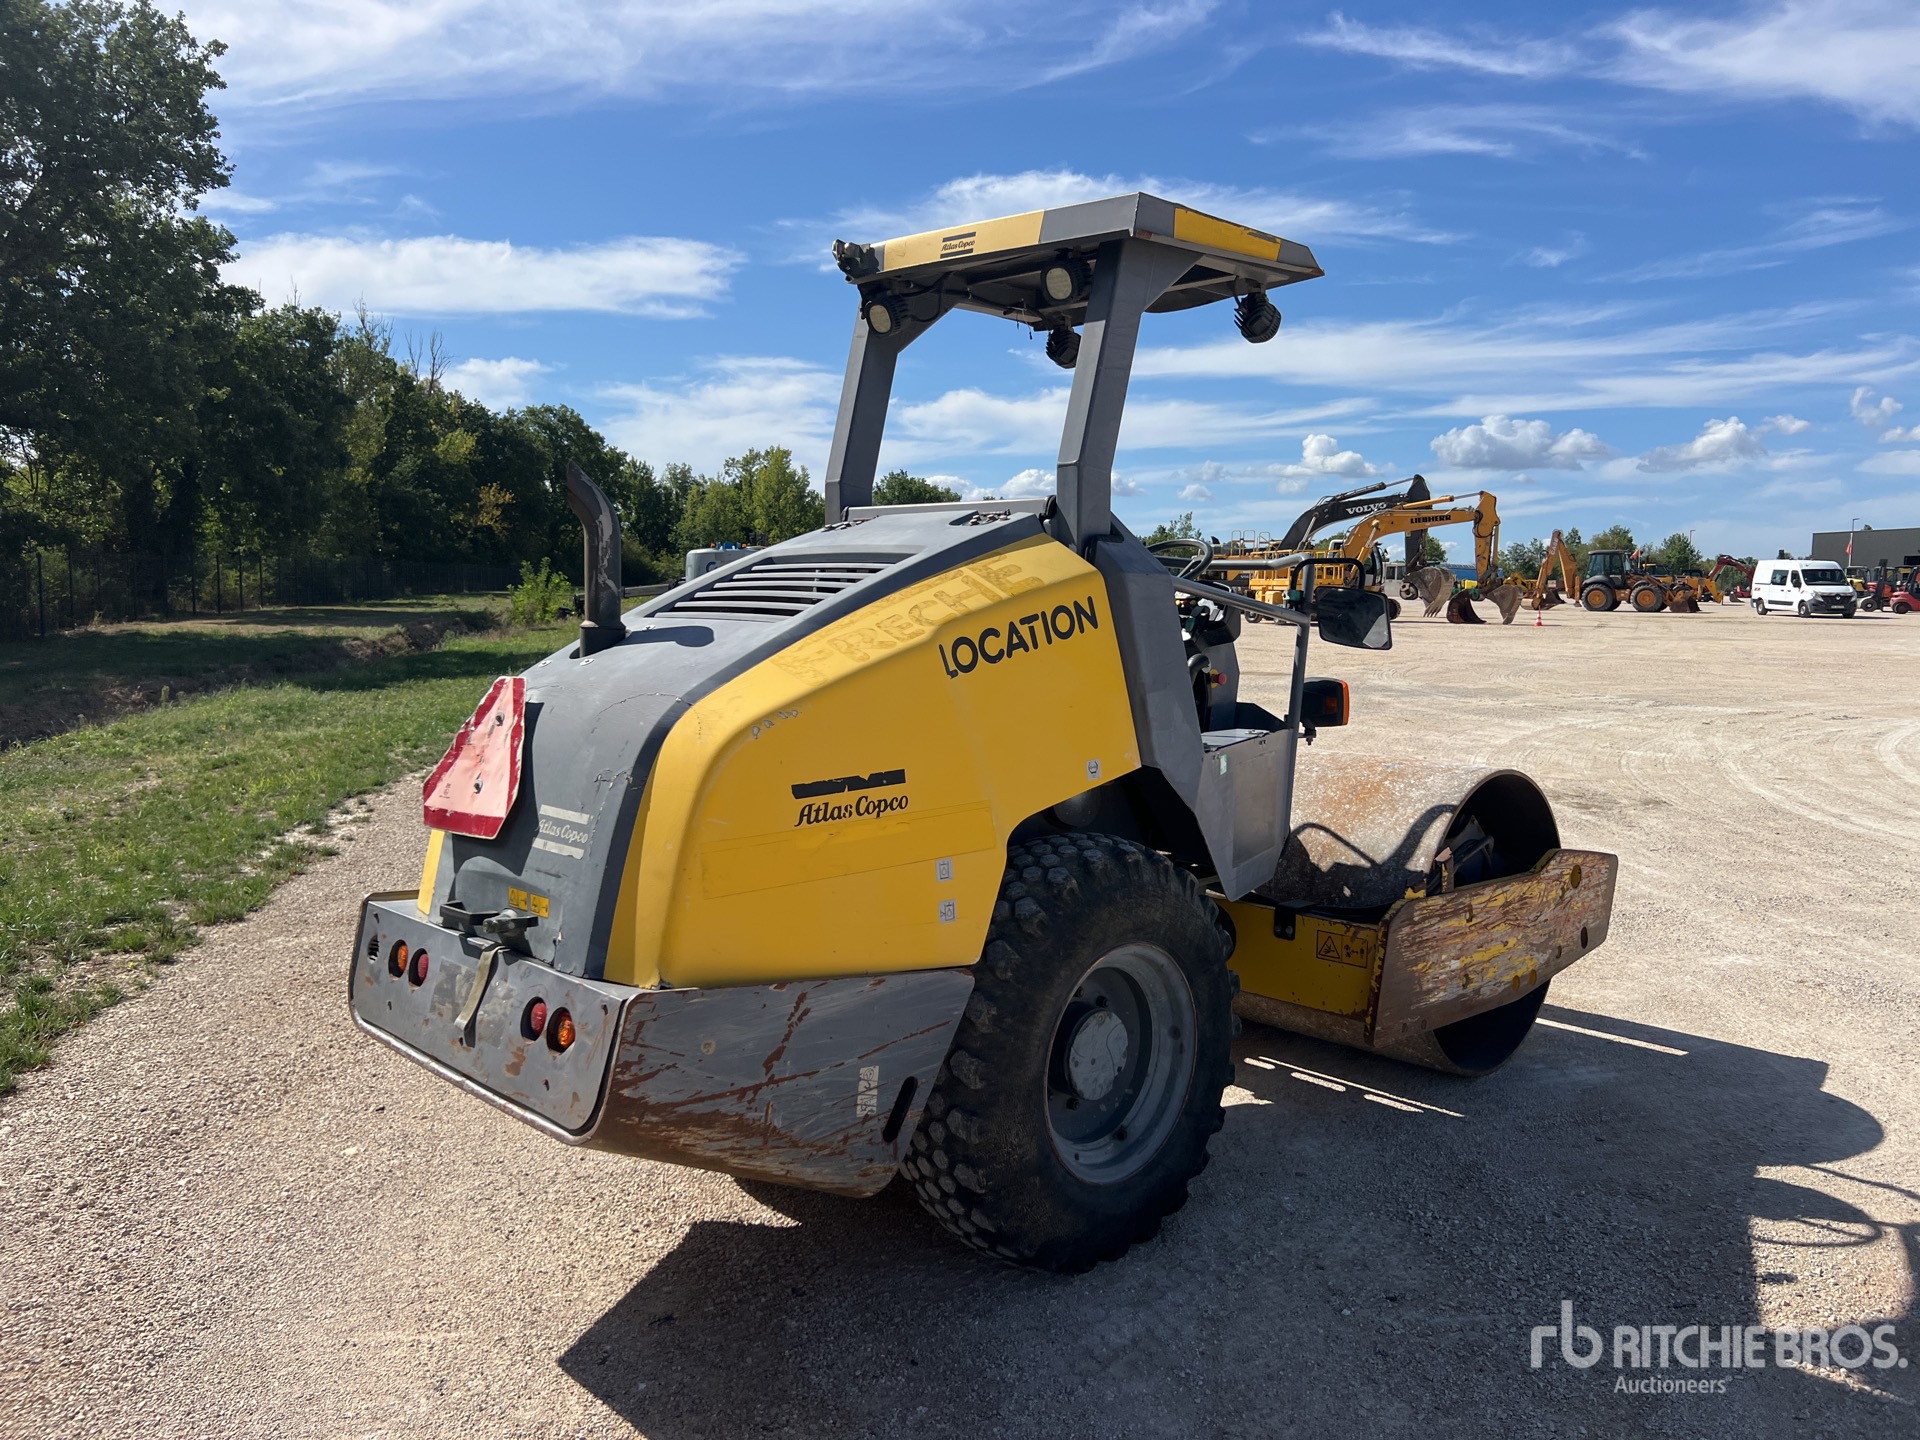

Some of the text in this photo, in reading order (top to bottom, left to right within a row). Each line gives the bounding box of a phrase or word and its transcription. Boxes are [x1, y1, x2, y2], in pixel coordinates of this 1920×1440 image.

[941, 240, 976, 251] Atlas Copco
[1346, 502, 1387, 515] VOLVO
[1410, 515, 1451, 524] LIEBHERR
[939, 596, 1099, 679] LOCATION
[794, 795, 909, 827] Atlas Copco
[535, 819, 588, 843] Atlas Copco
